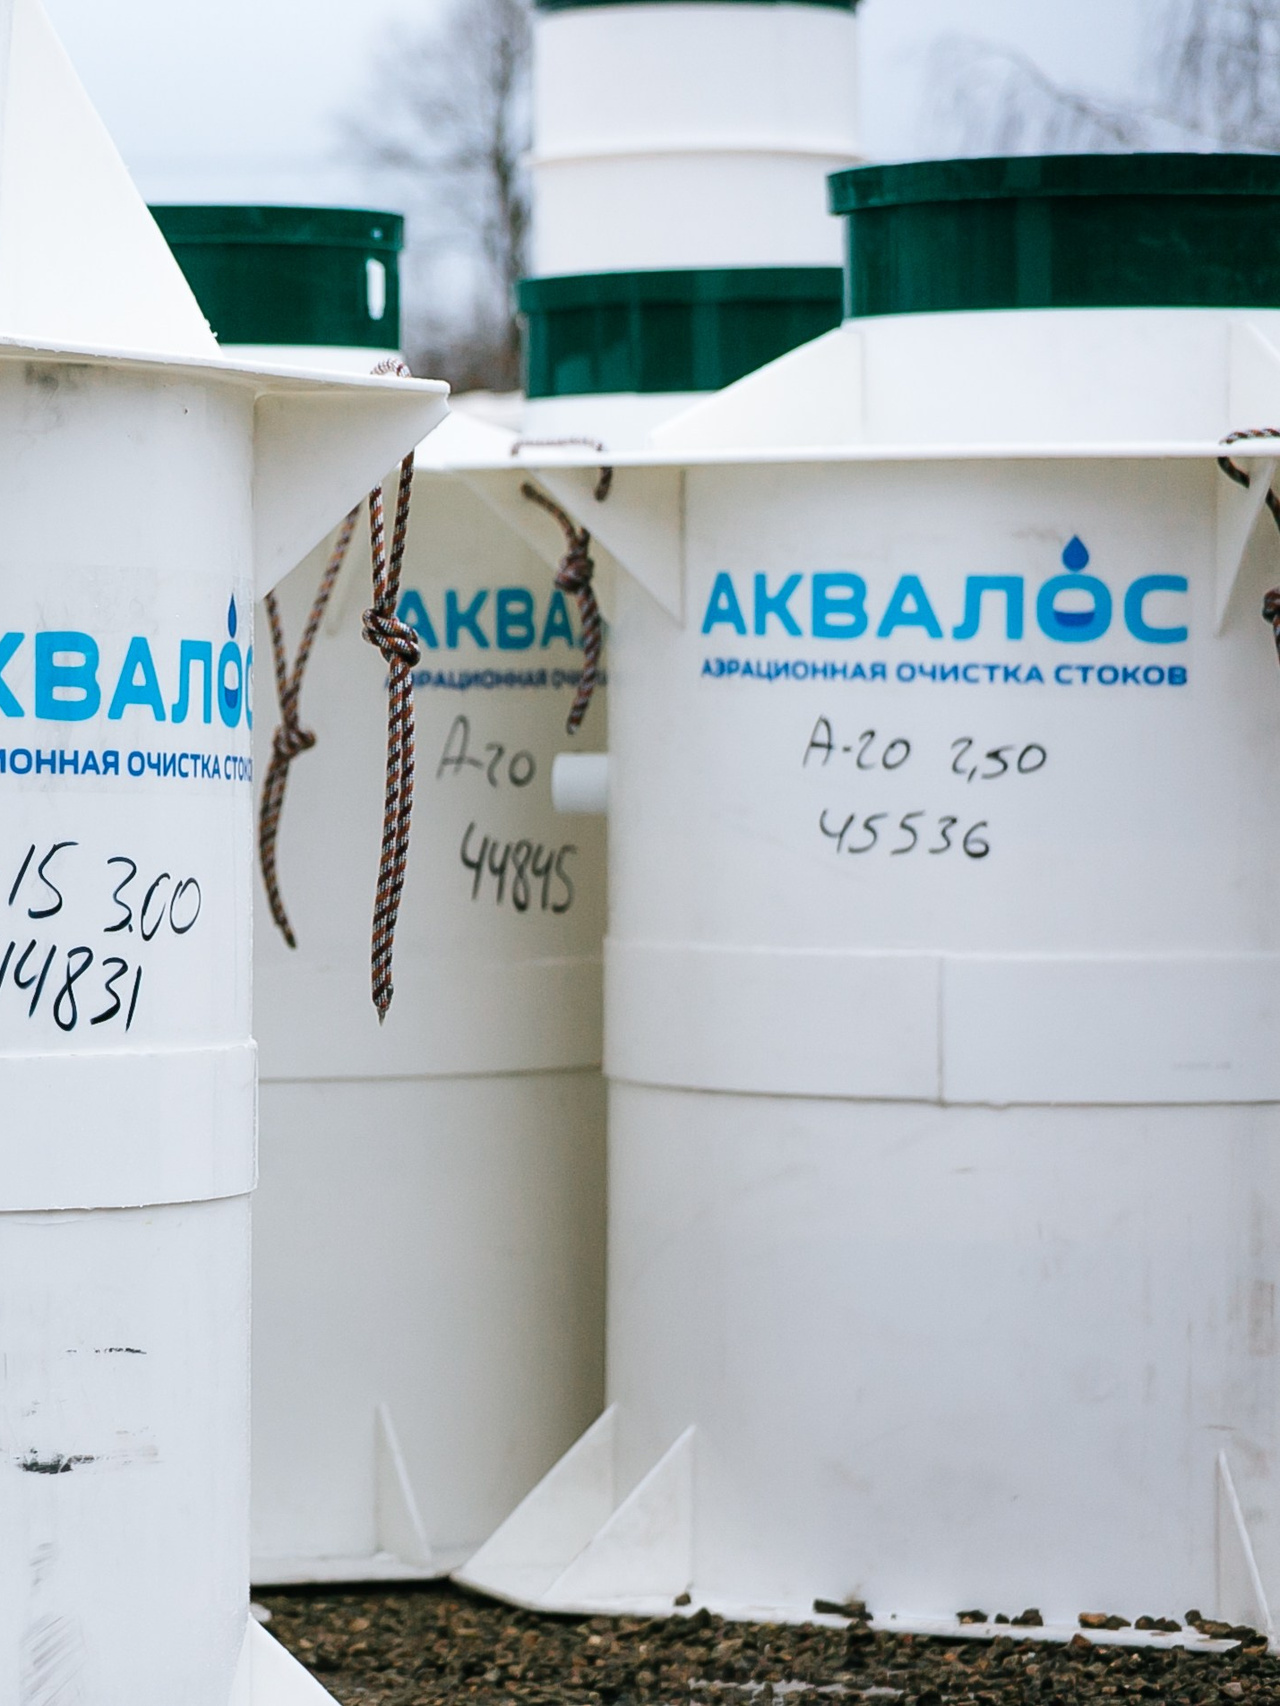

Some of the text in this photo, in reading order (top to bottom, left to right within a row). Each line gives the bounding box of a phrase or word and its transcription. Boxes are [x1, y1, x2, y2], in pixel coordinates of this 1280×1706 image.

[395, 588, 586, 651] АКВА
[701, 571, 1189, 645] АКВАЛОС
[702, 657, 1188, 687] АЭРАЦИОННАЯ ОЧИСТКА СТОКОВ
[127, 750, 221, 780] ОЧИСТКА
[951, 736, 1048, 783] 2,50
[819, 808, 991, 859] 45536
[460, 822, 577, 914] 44845
